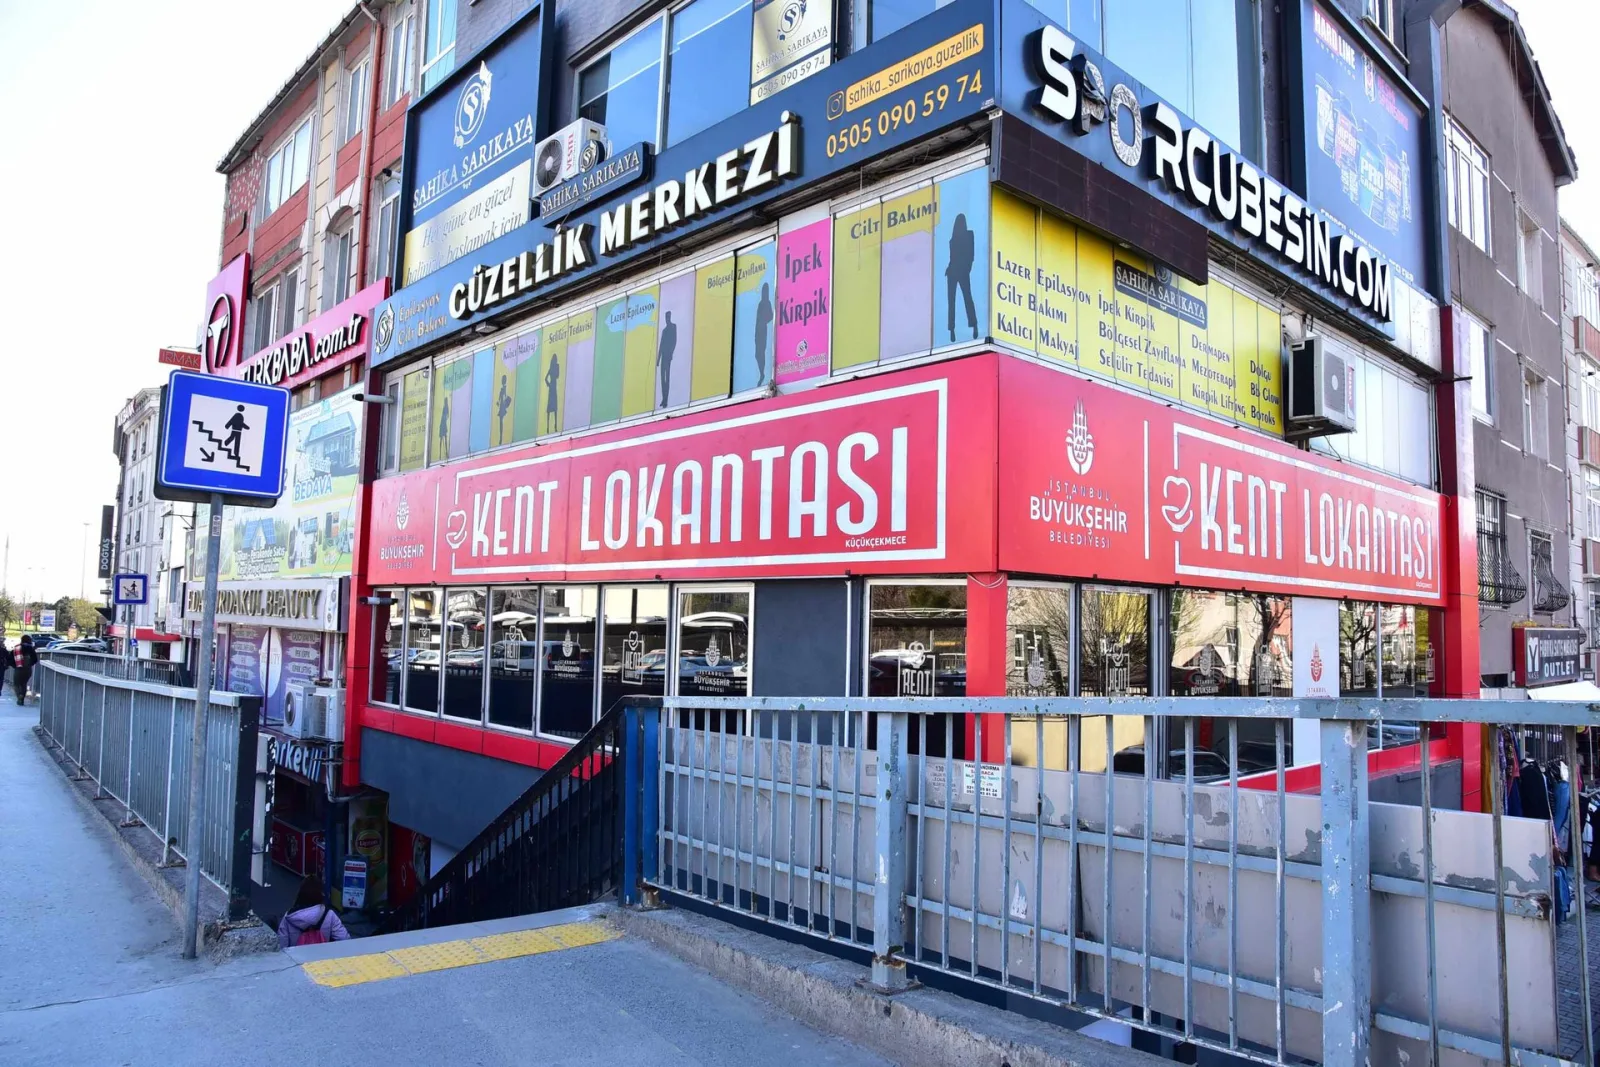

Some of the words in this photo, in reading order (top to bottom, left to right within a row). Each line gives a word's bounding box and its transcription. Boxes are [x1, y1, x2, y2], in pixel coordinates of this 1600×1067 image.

[757, 79, 778, 98] 0505
[781, 69, 798, 86] 090
[800, 61, 811, 76] 59
[814, 54, 825, 69] 74
[826, 118, 872, 158] 0505
[878, 99, 916, 136] 090
[922, 84, 949, 123] 59
[956, 69, 982, 102] 74
[461, 114, 534, 177] SARIKAYA
[582, 150, 640, 192] SARIKAYA
[449, 223, 589, 320] GÜZELLİK
[600, 110, 798, 255] MERKEZİ
[468, 201, 482, 221] en
[485, 176, 515, 217] güzel
[1158, 285, 1206, 320] SARIKAYA
[294, 474, 332, 502] BEDAVA
[472, 480, 557, 558] KENT
[581, 427, 908, 551] LOKANTASI
[1048, 476, 1110, 502] İSTANBUL
[1030, 490, 1128, 535] BÜYÜKŞEHİR
[1200, 462, 1288, 560] KENT
[1304, 488, 1433, 581] LOKANTASI
[845, 535, 907, 549] KÜÇÜKÇEKMECE
[265, 589, 322, 619] BEAUTY
[1544, 660, 1575, 678] OUTLET
